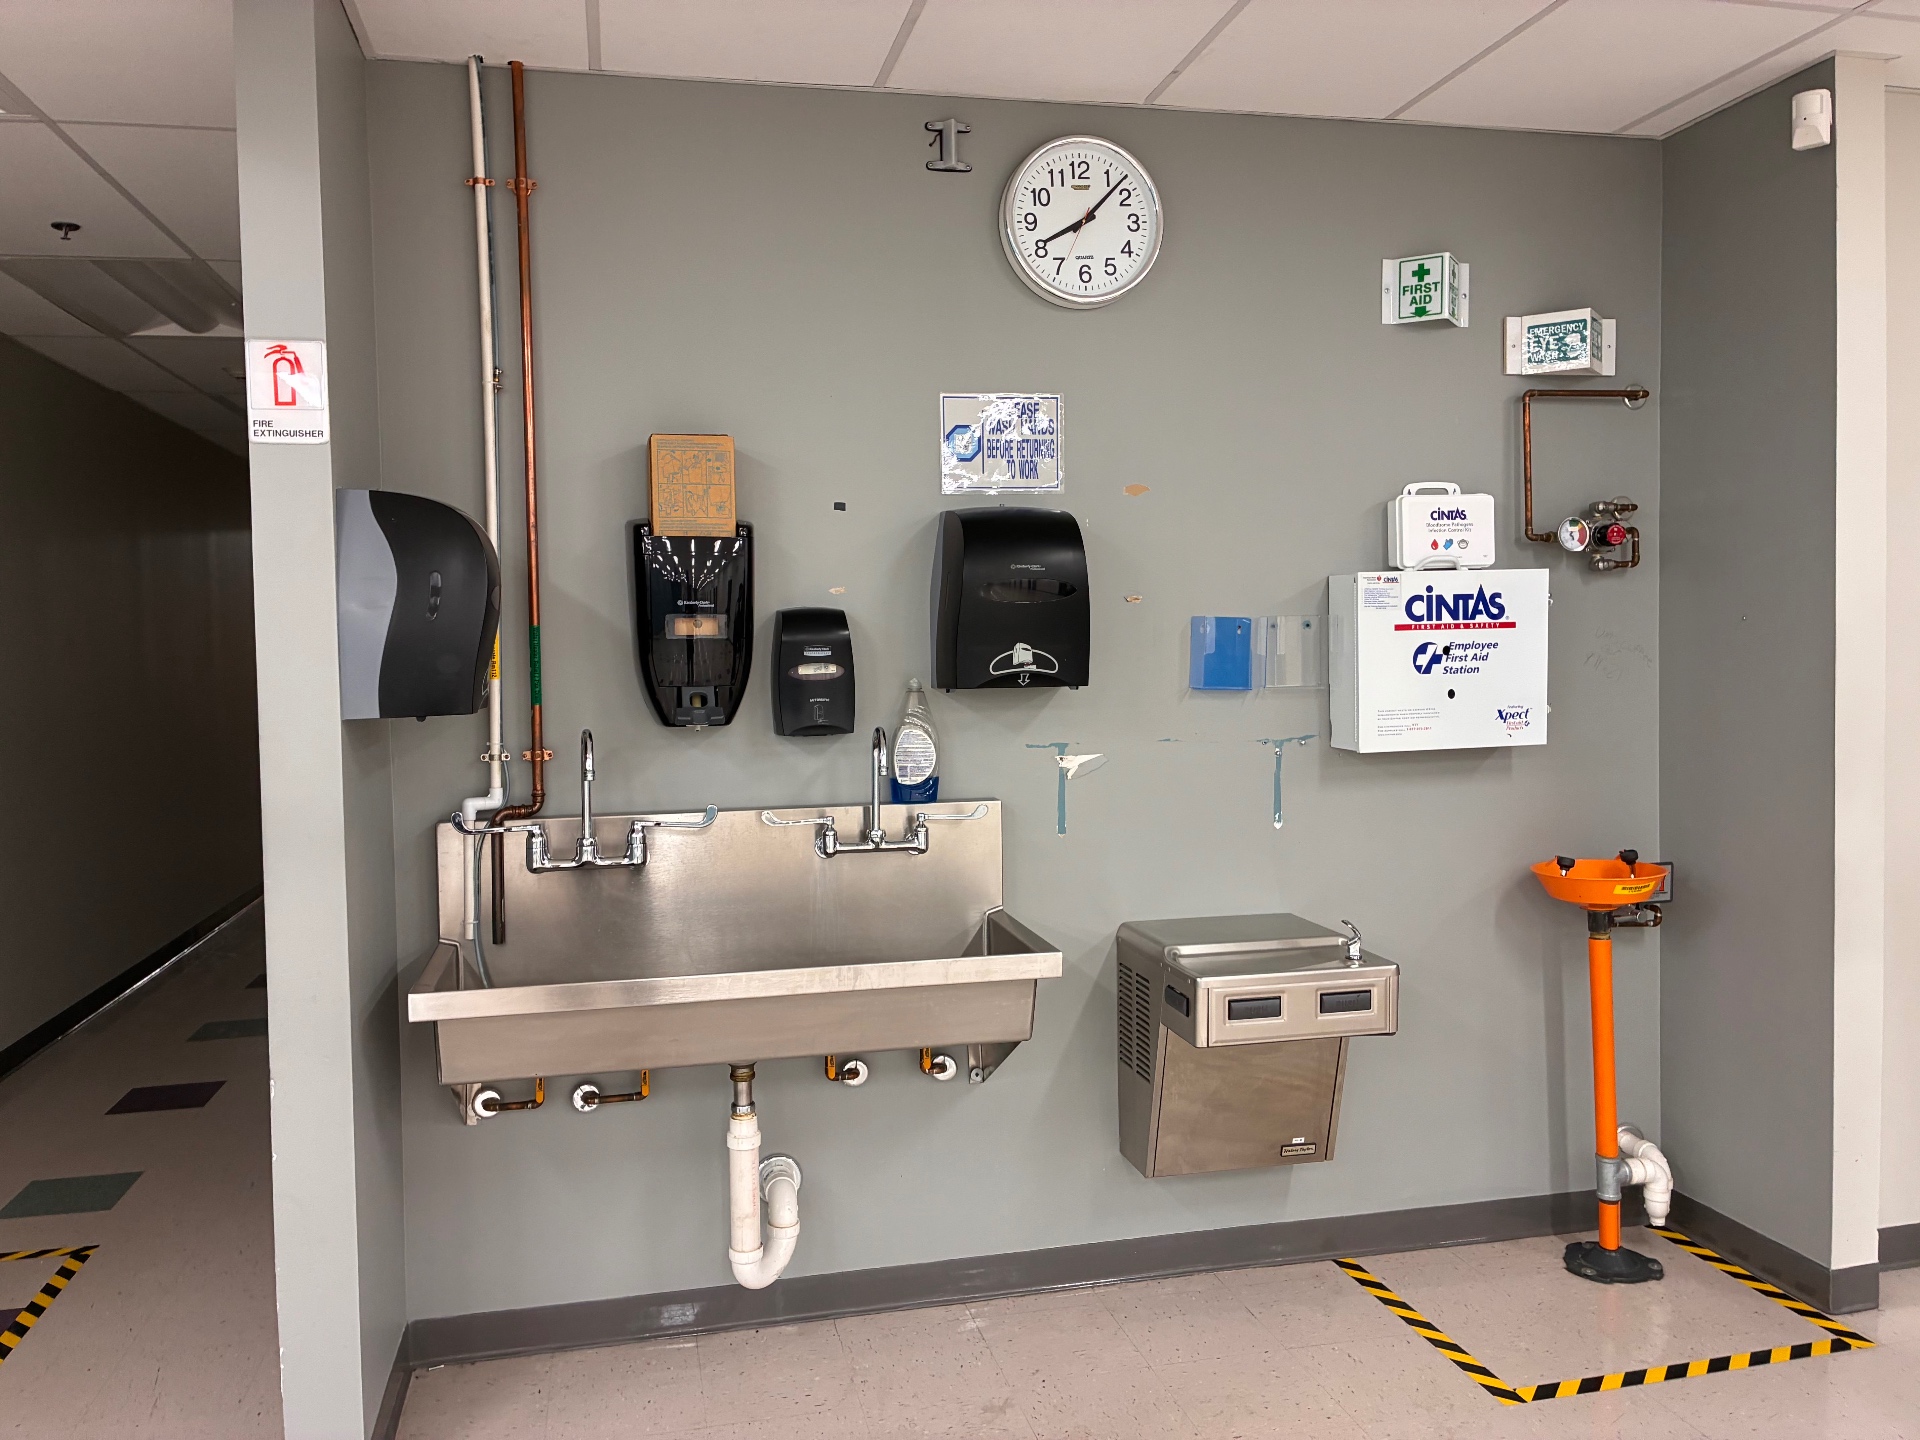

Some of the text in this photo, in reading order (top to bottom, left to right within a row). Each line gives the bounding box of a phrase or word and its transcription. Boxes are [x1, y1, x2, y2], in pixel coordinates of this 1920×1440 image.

[1048, 168, 1065, 188] 11
[1069, 160, 1090, 180] 12
[1103, 168, 1111, 188] 1
[1030, 187, 1051, 207] 10
[1118, 187, 1132, 207] 2
[1023, 212, 1038, 232] 9
[1127, 212, 1141, 232] 3
[1034, 239, 1048, 259] 8
[1120, 239, 1134, 258] 4
[1053, 257, 1066, 276] 7
[1078, 264, 1093, 284] 6
[1104, 257, 1117, 276] 5
[1402, 281, 1441, 296] FIRST
[1409, 294, 1433, 307] AID
[1529, 321, 1585, 336] EMERGENCY
[1528, 335, 1560, 352] EYE
[1529, 349, 1559, 363] WASH
[253, 420, 274, 428] FIRE
[253, 429, 324, 438] EXTINGUISHER
[987, 438, 1055, 460] BEFORE RETURNING
[1007, 459, 1039, 480] TO WORK
[1449, 640, 1499, 652] Employee
[1445, 652, 1490, 662] First Aid
[1442, 664, 1480, 674] Station
[1495, 707, 1530, 724] Xpect
